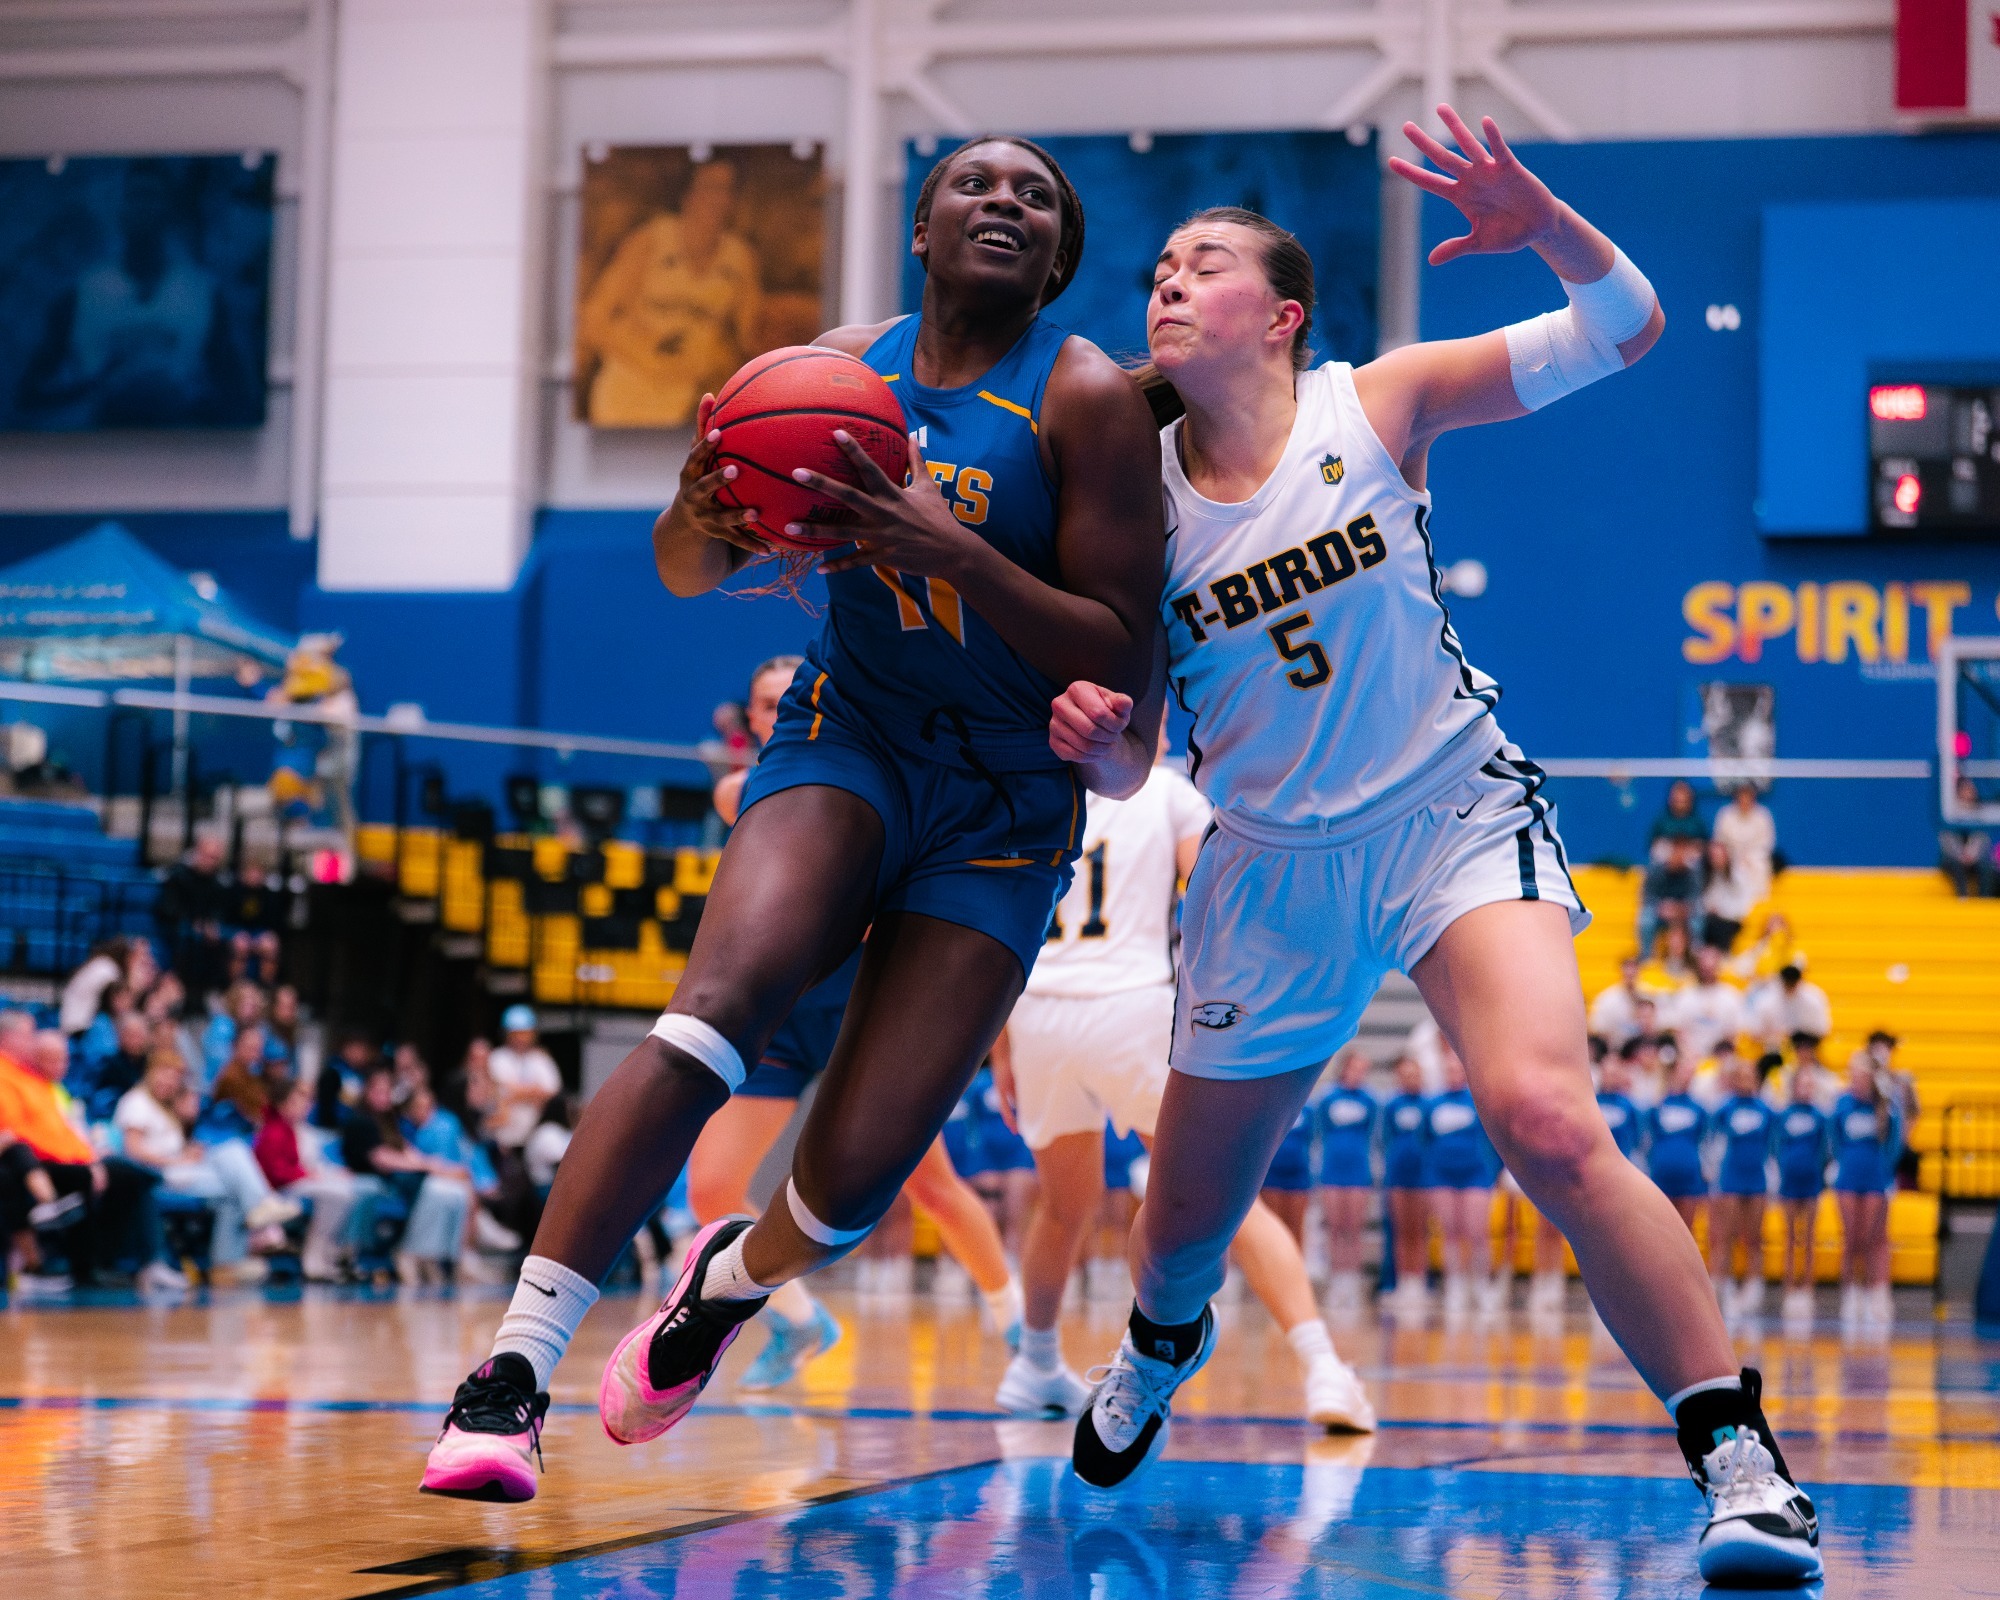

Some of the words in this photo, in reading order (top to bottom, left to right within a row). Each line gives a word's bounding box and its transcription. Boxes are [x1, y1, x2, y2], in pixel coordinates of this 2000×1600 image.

[1169, 511, 1388, 643] T-BIRDS
[1266, 608, 1334, 692] 5
[1681, 579, 1972, 665] SPIRIT
